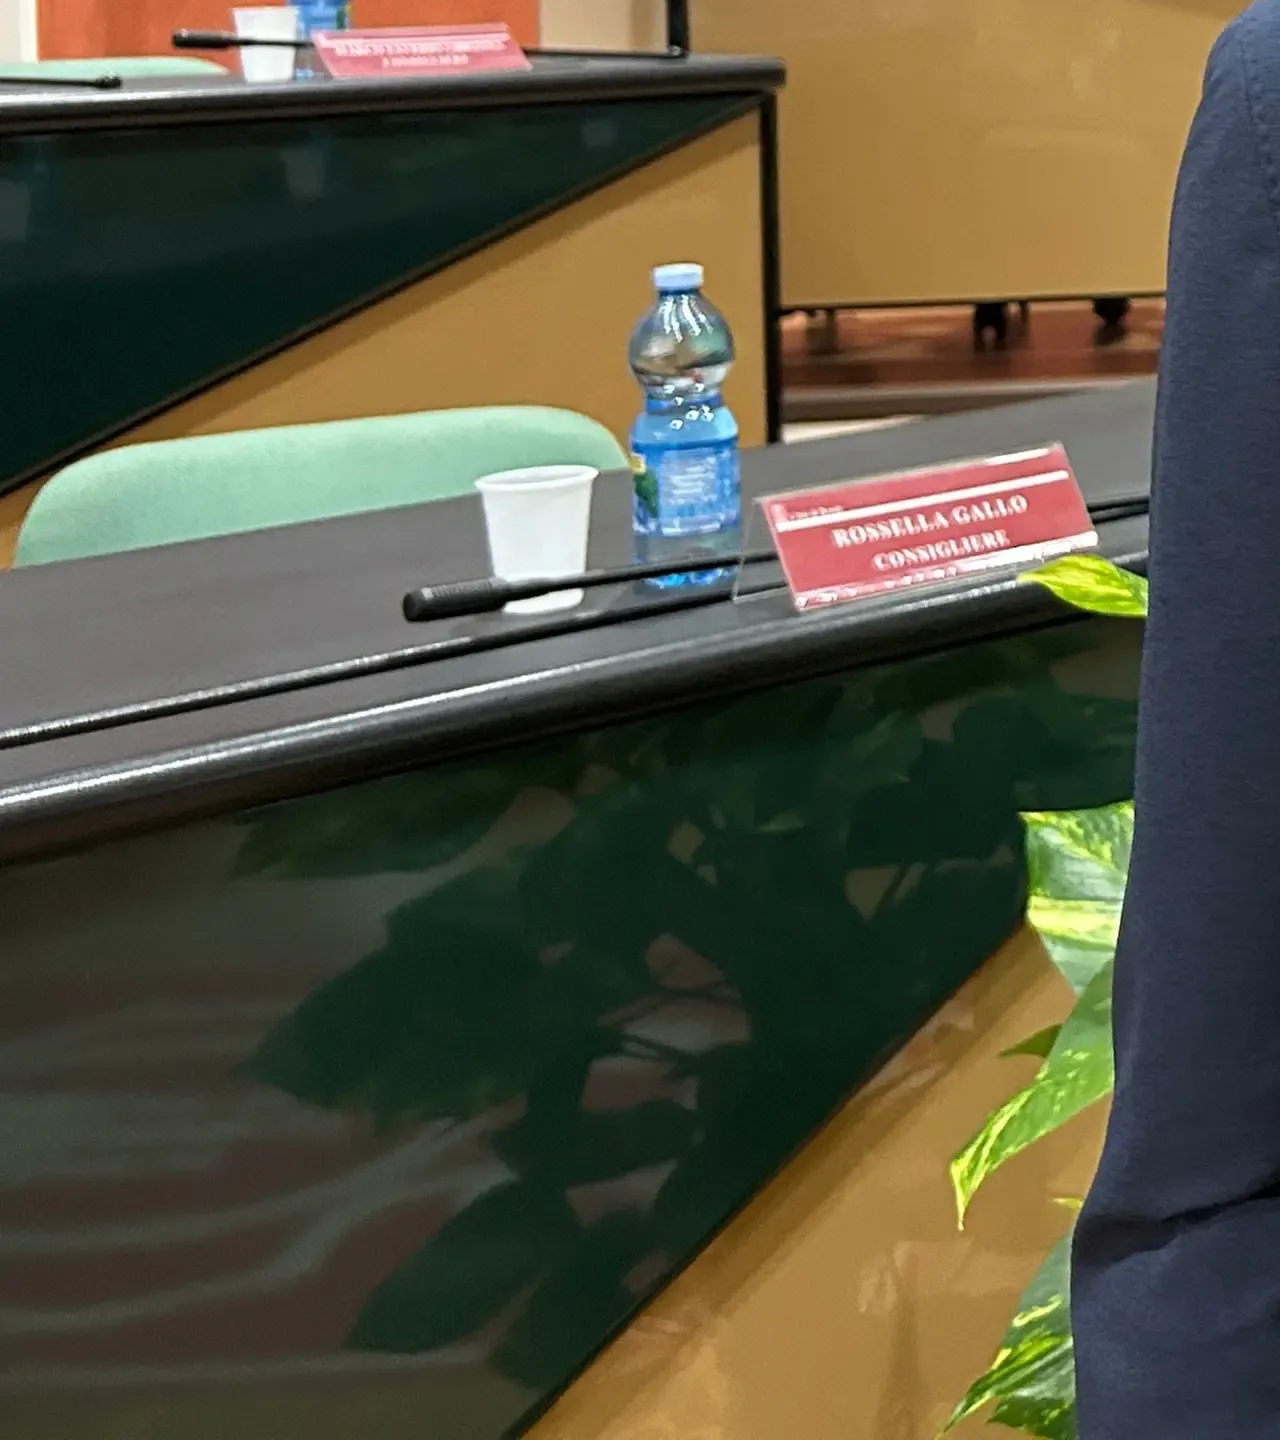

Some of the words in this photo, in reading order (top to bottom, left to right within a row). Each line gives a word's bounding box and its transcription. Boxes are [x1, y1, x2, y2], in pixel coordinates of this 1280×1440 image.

[831, 512, 949, 549] ROSSELLA
[951, 494, 1030, 524] GALLO
[872, 528, 1012, 572] CONSIGLIERE
